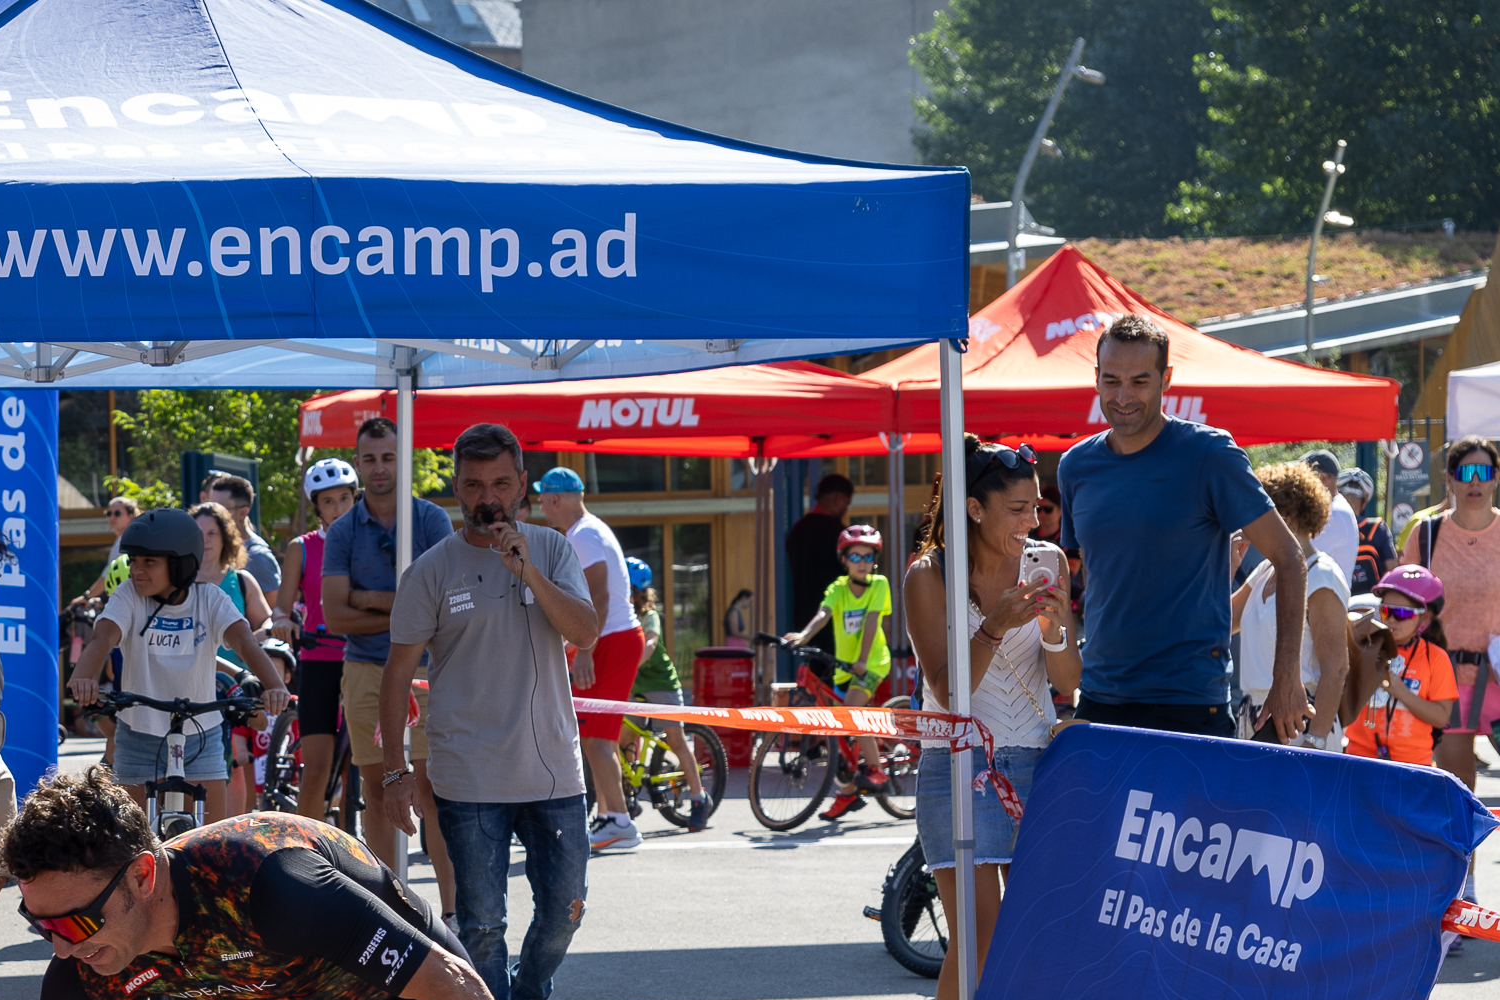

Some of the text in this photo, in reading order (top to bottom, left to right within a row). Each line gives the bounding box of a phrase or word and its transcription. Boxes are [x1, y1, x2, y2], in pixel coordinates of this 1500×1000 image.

[577, 397, 700, 429] MOTUL
[450, 601, 475, 614] MOTUL
[789, 708, 843, 729] MOTUL
[1114, 788, 1325, 909] Encamp
[358, 927, 387, 966] 226ERS
[1098, 888, 1302, 973] El Pas de la Casa
[221, 949, 254, 962] Santini
[385, 941, 413, 986] SCOTT
[124, 968, 159, 994] MOTUL
